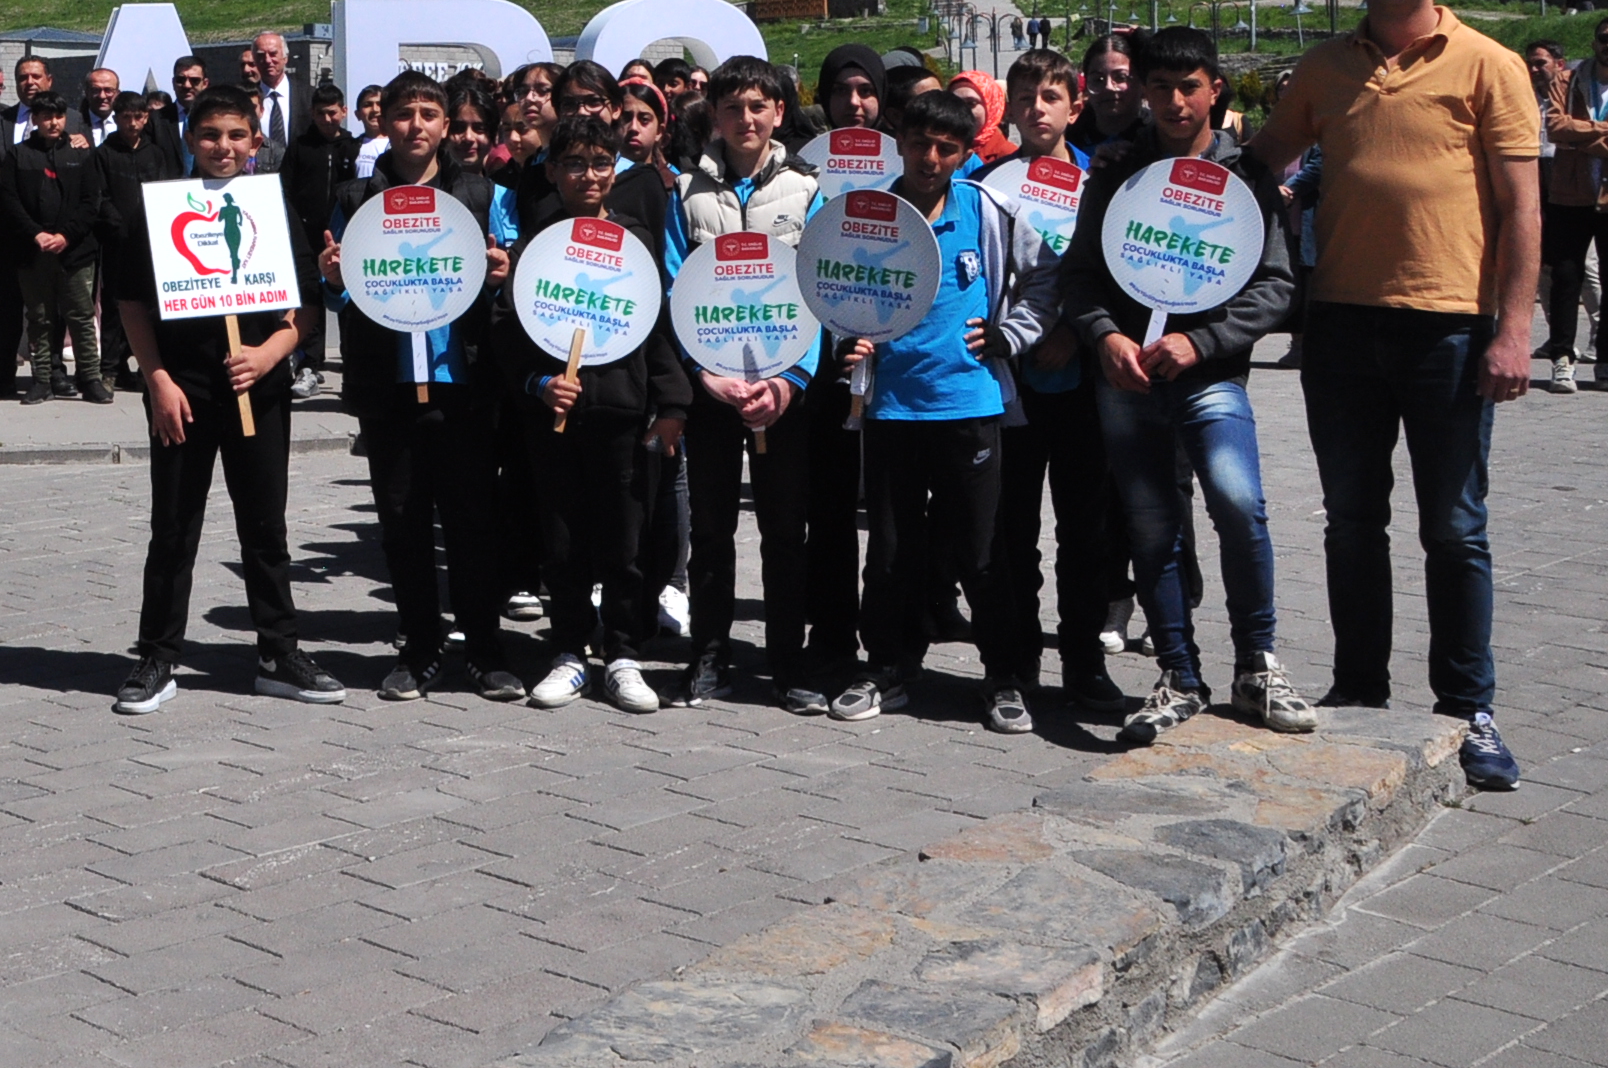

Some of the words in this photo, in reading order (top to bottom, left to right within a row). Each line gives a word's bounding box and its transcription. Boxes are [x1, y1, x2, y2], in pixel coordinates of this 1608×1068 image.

[1126, 219, 1236, 265] HAREKETE
[363, 256, 465, 277] HAREKETE
[1122, 242, 1189, 268] ÇOCUKLUKTA
[1192, 261, 1225, 278] BAŞLA
[162, 277, 221, 292] OBEZİTEYE
[244, 272, 276, 287] KARŞI
[365, 278, 429, 289] ÇOCUKLUKTA
[432, 277, 463, 287] BAŞLA
[817, 258, 918, 289] HAREKETE
[164, 299, 188, 312] HER
[191, 295, 216, 310] GÜN
[220, 295, 233, 307] 10
[236, 290, 256, 305] BİN
[259, 290, 288, 303] ADIM
[535, 278, 637, 316] HAREKETE
[817, 282, 878, 297] ÇOCUKLUKTA
[881, 291, 912, 301] BAŞLA
[534, 300, 597, 322] ÇOCUKLUKTA
[599, 316, 630, 328] BAŞLA
[695, 303, 799, 325] HAREKETE
[697, 325, 762, 336] ÇOCUKLUKTA
[765, 325, 798, 334] BAŞLA
